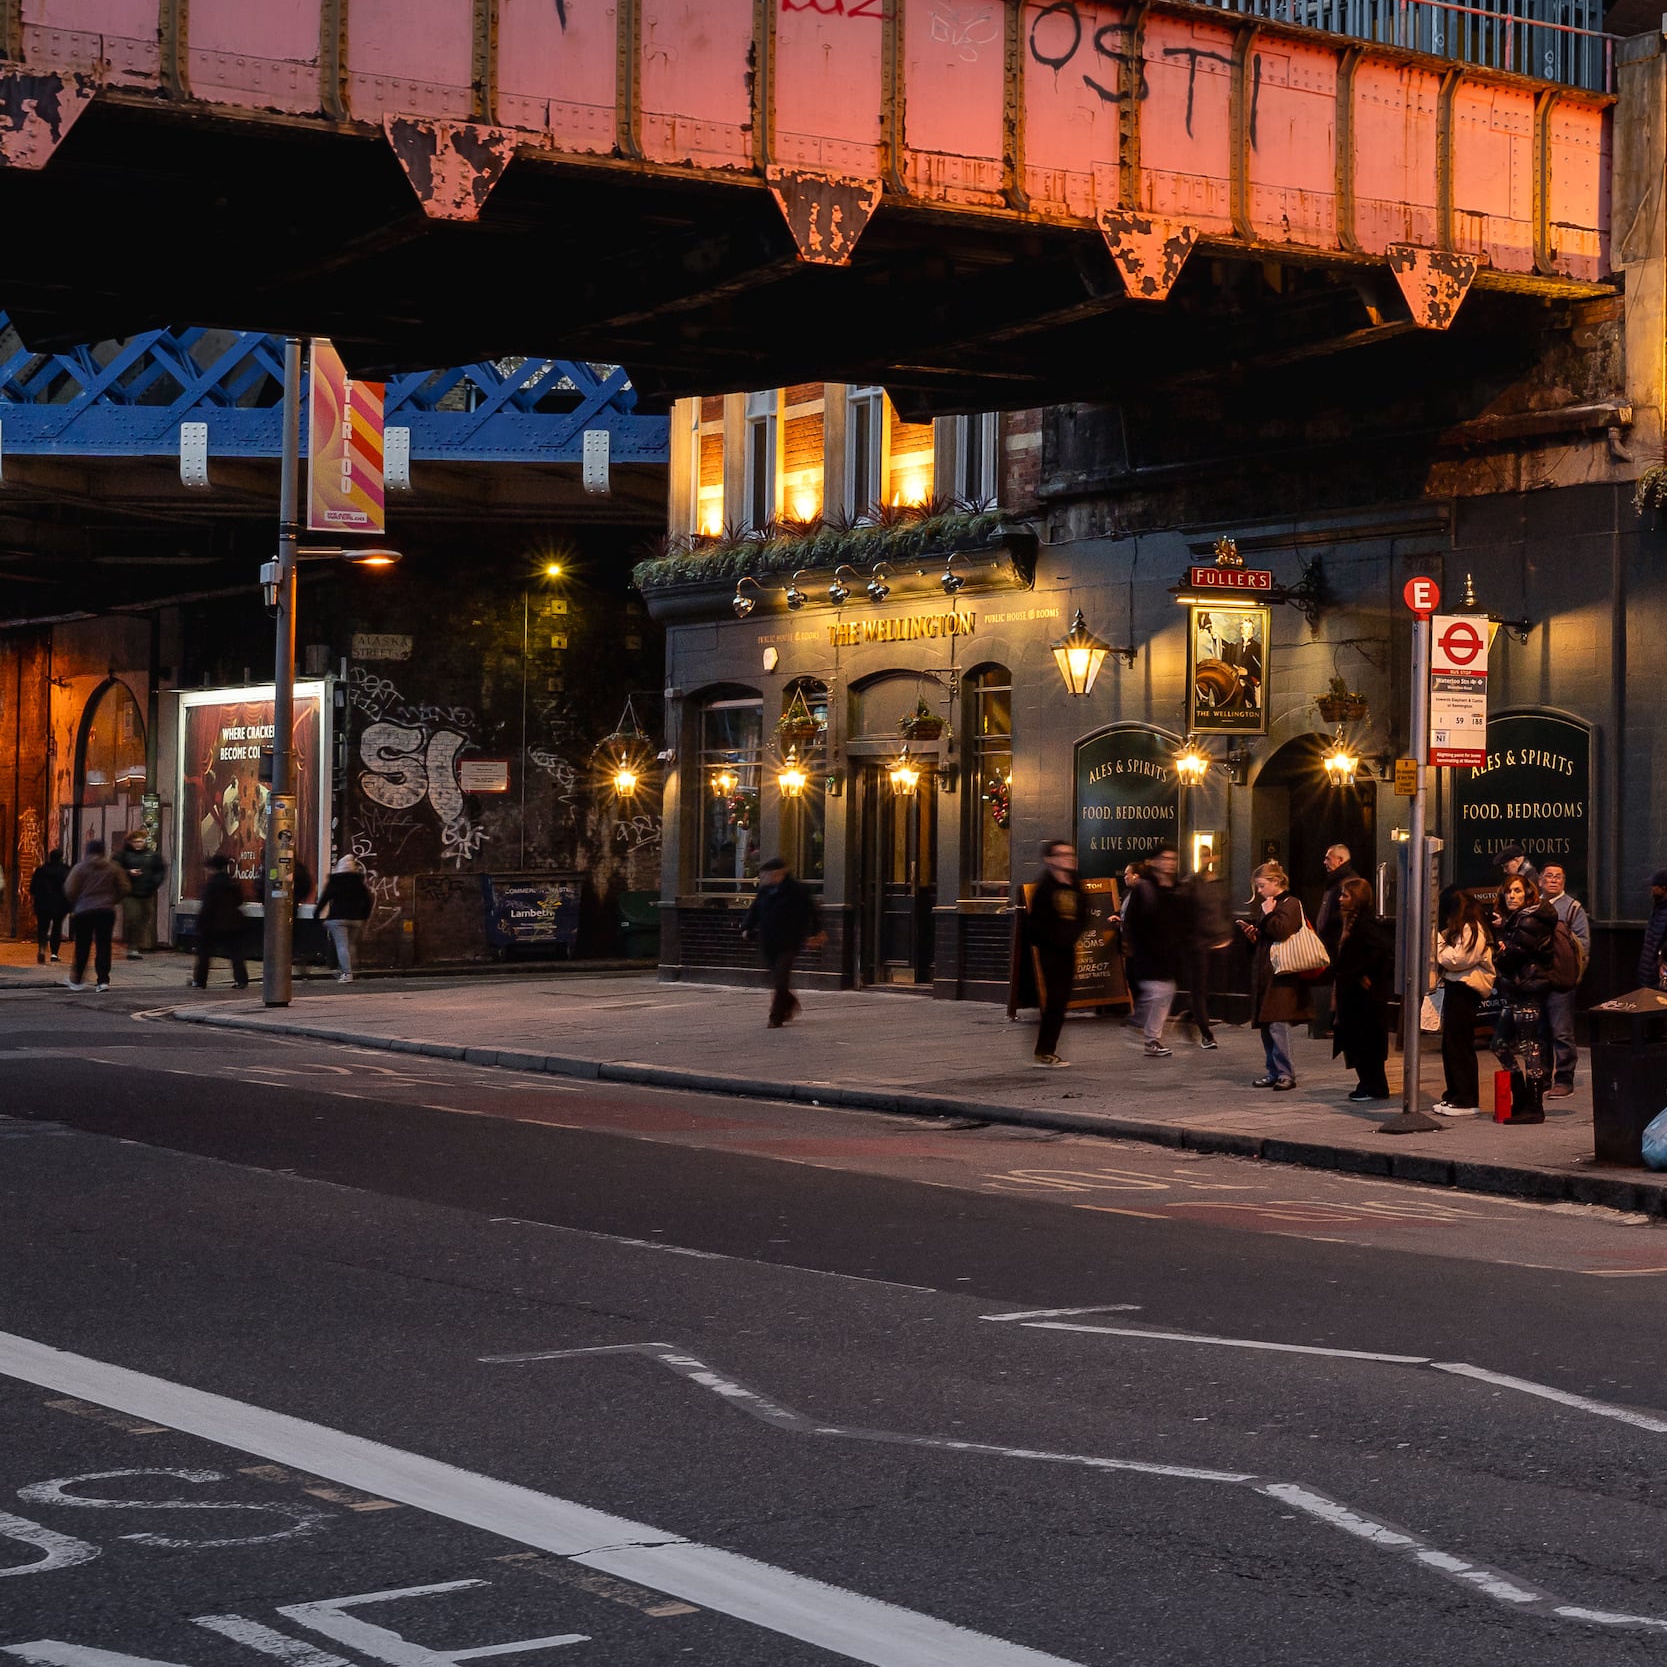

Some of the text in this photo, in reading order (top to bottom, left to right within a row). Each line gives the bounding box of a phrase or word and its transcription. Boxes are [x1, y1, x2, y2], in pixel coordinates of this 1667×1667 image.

[1196, 569, 1267, 587] FULLER'S
[1414, 583, 1431, 608] E
[984, 608, 1059, 623] PUBLIC HOUSE ROOMS
[827, 611, 976, 646] THE WELLINGTON
[1436, 677, 1460, 685] Waterloo
[1213, 710, 1260, 718] WELLINGTON
[222, 726, 246, 740] WHERE
[220, 746, 246, 760] BECOME
[1506, 749, 1516, 766] &
[1521, 749, 1575, 776] SPIRITS
[1089, 758, 1168, 784] ALES & SPIRITS
[1116, 805, 1175, 820] BEDROOMS
[1507, 802, 1583, 819] BEDROOMS
[1090, 836, 1098, 850] &
[1101, 836, 1122, 850] LIVE
[1473, 838, 1482, 854] &
[1521, 838, 1570, 854] SPORTS
[241, 851, 256, 860] HOTEL
